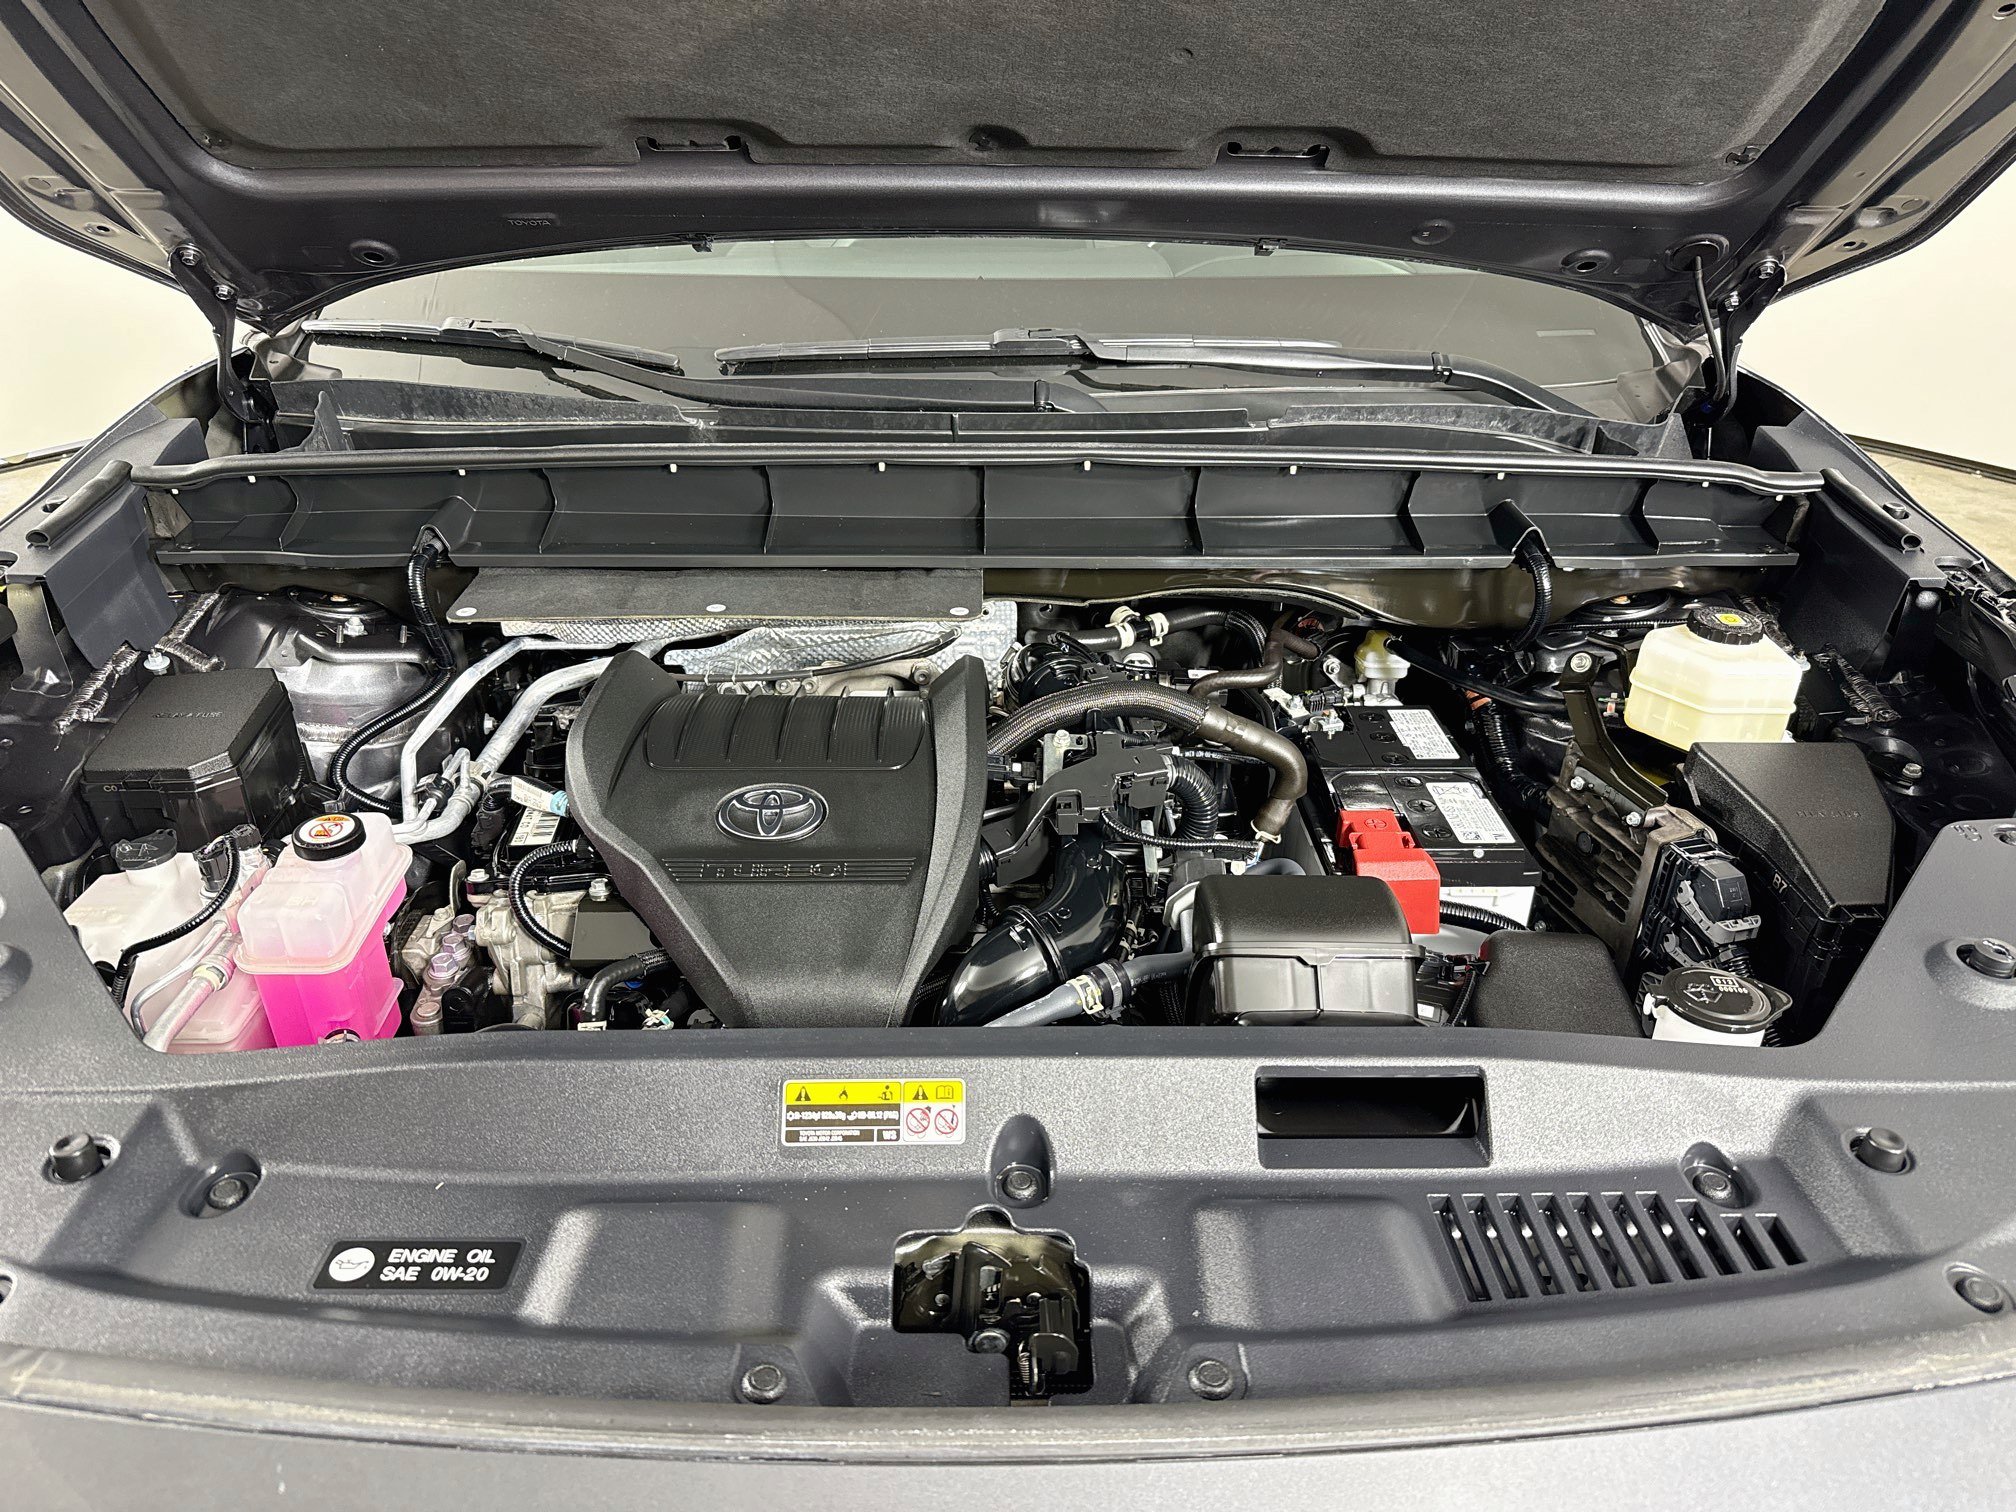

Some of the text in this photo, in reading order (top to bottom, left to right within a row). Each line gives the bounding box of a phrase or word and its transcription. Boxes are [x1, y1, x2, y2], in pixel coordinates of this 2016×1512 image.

[507, 218, 552, 227] TOYOTA
[705, 863, 842, 878] TURBO
[1772, 872, 1788, 894] B7
[387, 1248, 496, 1264] ENGINE OIL
[379, 1265, 490, 1282] SAE 0W-20
